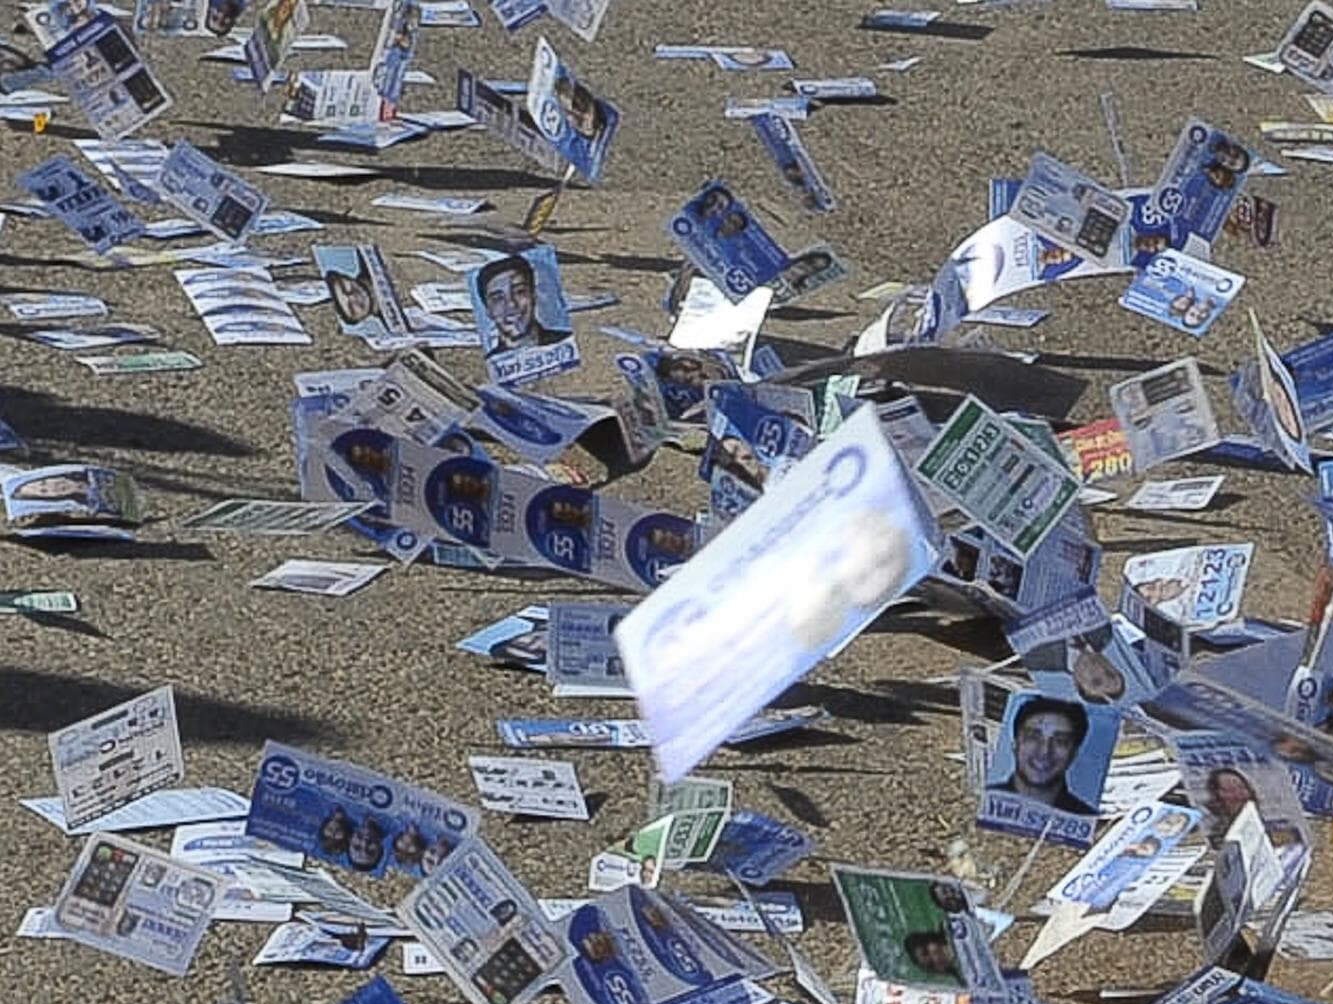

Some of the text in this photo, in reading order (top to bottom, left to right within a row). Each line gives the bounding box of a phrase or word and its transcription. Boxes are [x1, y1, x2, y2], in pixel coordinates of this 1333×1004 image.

[725, 267, 753, 294] 55
[759, 421, 781, 454] 55
[1195, 548, 1226, 615] 12123
[264, 761, 299, 788] 55
[670, 940, 696, 973] 55
